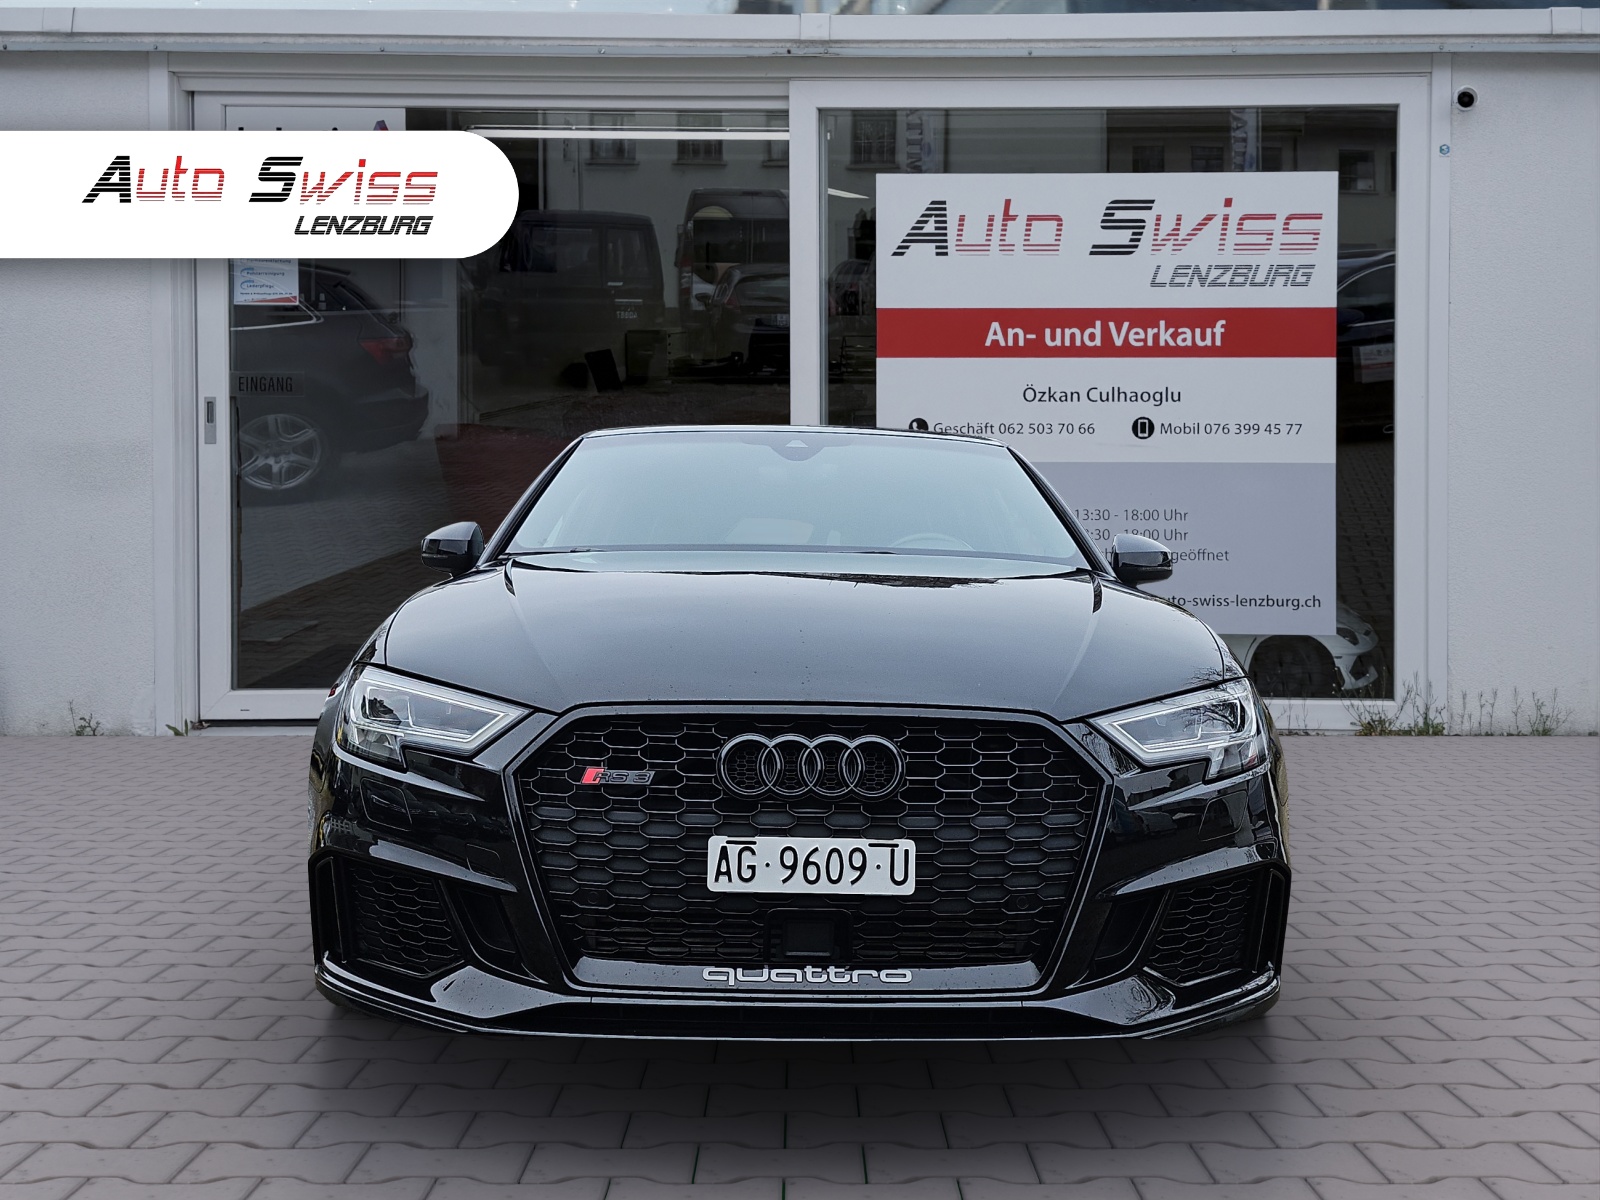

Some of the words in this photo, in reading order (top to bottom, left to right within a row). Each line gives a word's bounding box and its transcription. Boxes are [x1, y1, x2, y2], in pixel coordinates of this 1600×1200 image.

[891, 199, 1063, 257] Auto
[1089, 198, 1323, 256] Swiss
[1150, 264, 1316, 288] LENZBURG
[984, 322, 1036, 347] An-
[1045, 320, 1101, 347] und
[1108, 319, 1226, 347] Verkauf
[238, 376, 293, 393] EINGANG
[1022, 384, 1081, 403] Özkan
[1086, 386, 1182, 407] Culhaoglu
[933, 421, 995, 436] Geschäft
[998, 422, 1024, 435] 062
[1028, 422, 1054, 435] 503
[1057, 422, 1075, 435] 70
[1077, 422, 1096, 435] 66
[1159, 421, 1200, 435] Mobil
[1203, 422, 1231, 435] 076
[1234, 422, 1261, 435] 399
[1263, 423, 1282, 435] 45
[1285, 423, 1303, 436] 77
[1074, 508, 1110, 521] 13:30
[1124, 508, 1160, 521] 18:00
[1163, 508, 1189, 522] Uhr
[1163, 528, 1189, 542] Uhr
[1170, 548, 1230, 564] geöffnet
[702, 966, 912, 986] quattro
